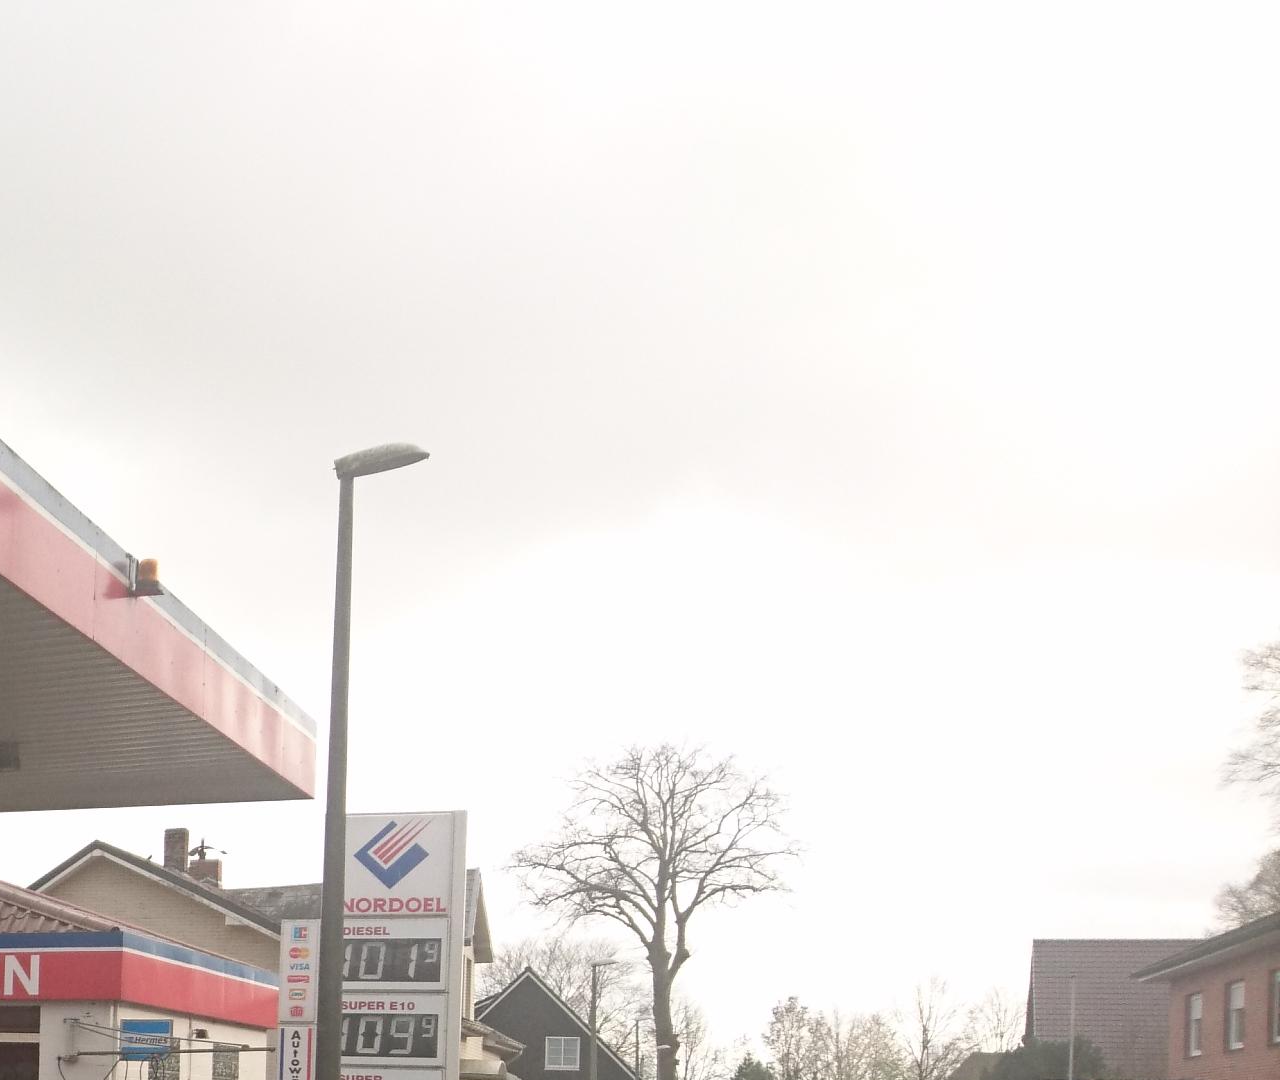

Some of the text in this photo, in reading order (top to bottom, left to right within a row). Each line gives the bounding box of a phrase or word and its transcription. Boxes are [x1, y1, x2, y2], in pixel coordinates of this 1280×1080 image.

[343, 897, 446, 912] NORDOEL
[343, 926, 390, 936] DIESEL
[289, 963, 310, 971] VISA
[342, 1001, 415, 1011] SUPER E10
